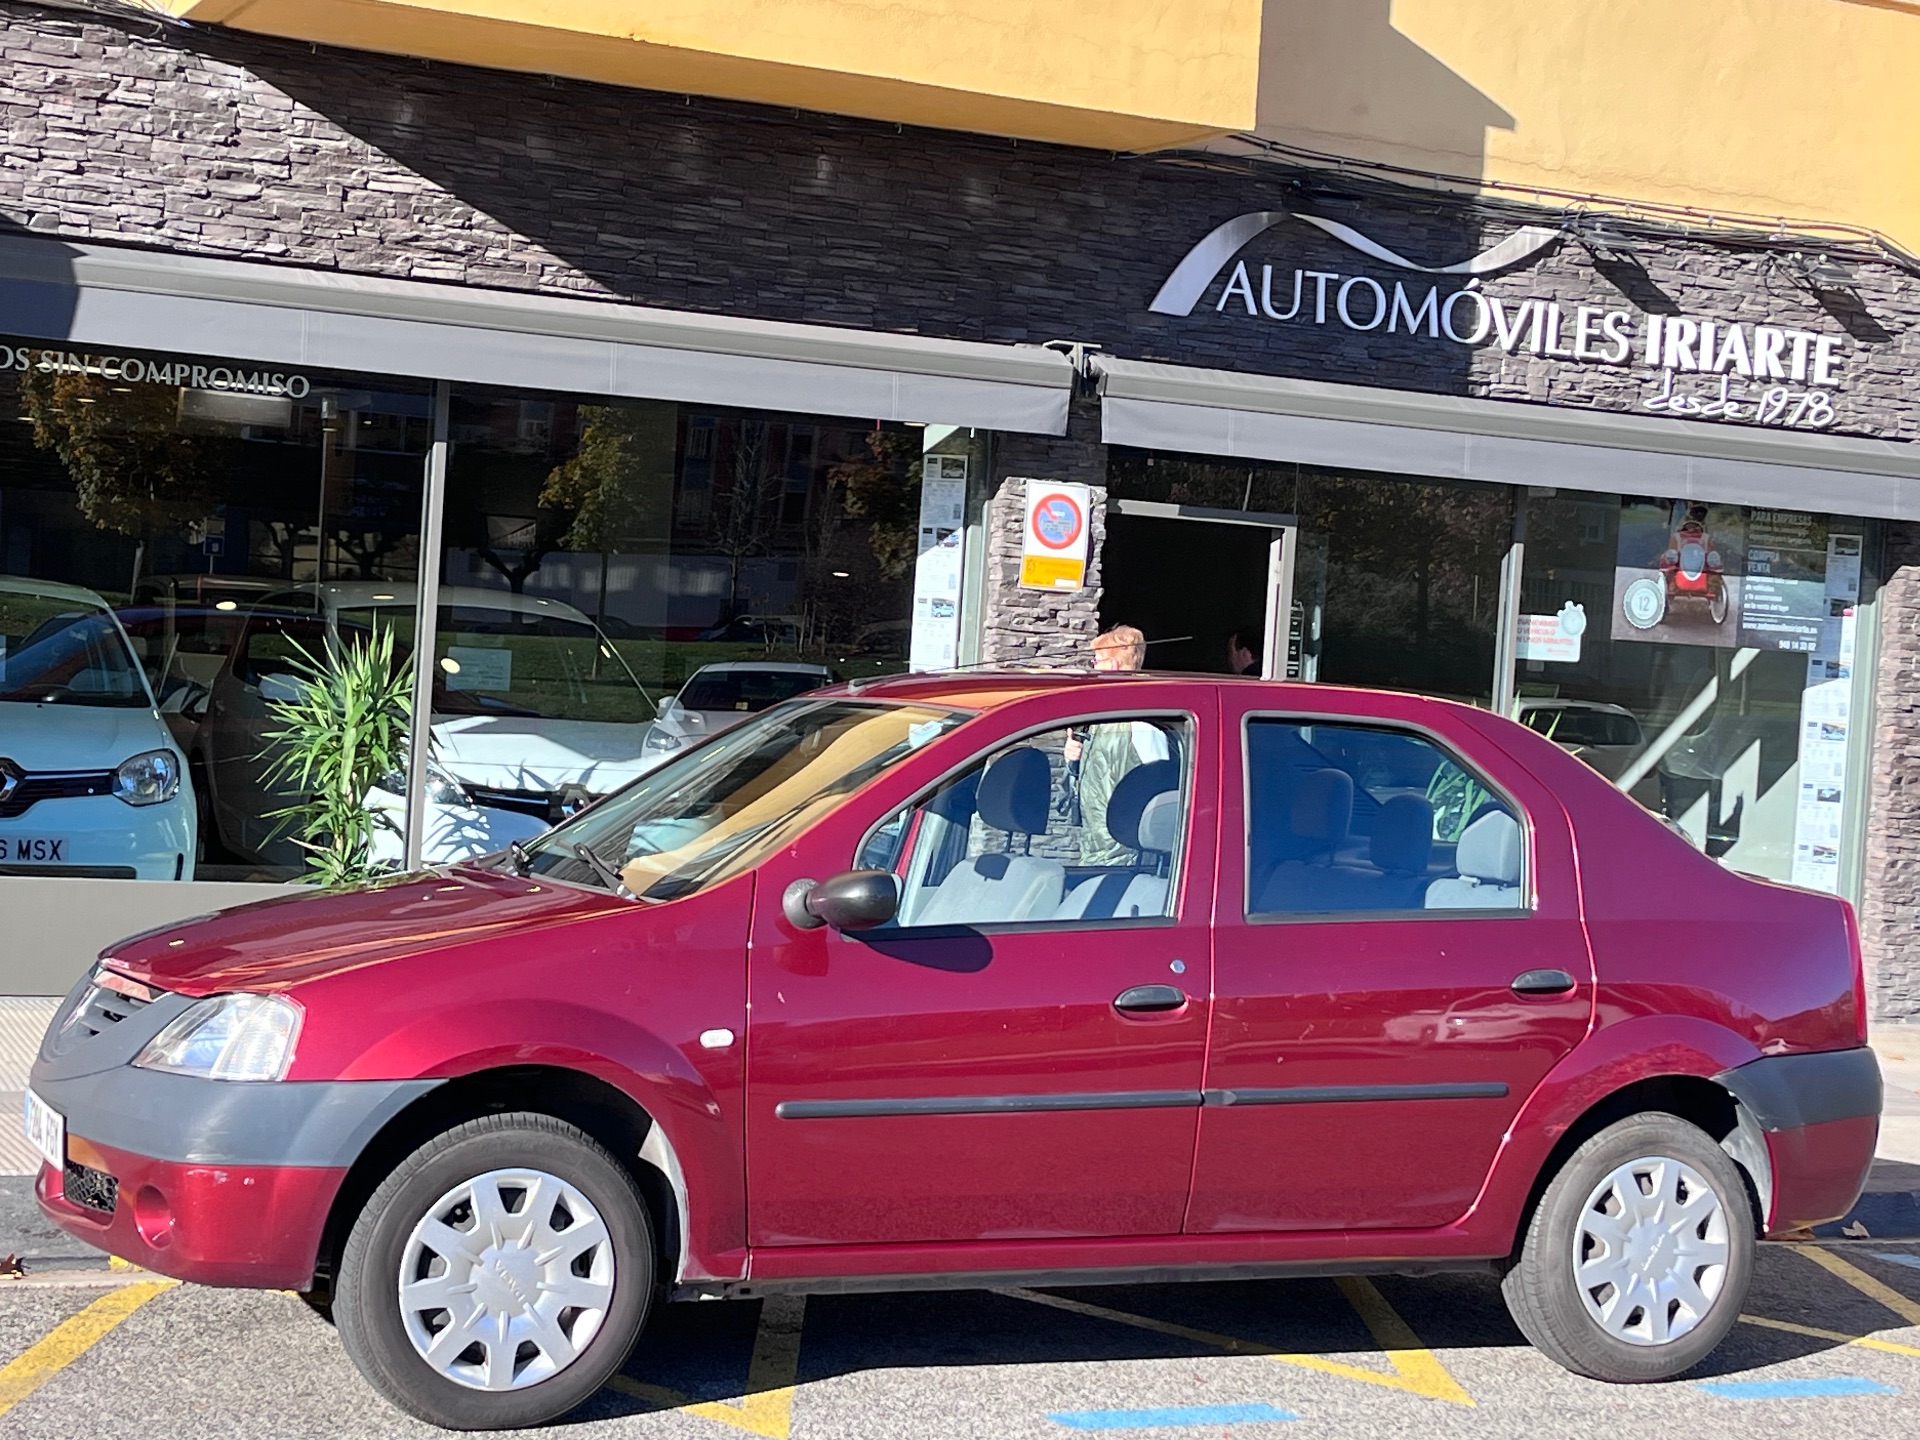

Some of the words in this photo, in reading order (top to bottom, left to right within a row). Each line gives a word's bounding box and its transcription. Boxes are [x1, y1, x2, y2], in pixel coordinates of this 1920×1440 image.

[1216, 260, 1633, 365] AUTOMÓVILES
[1644, 313, 1843, 387] IRIARTE
[39, 350, 90, 376] SIN
[99, 355, 311, 399] COMPROMISO
[1642, 367, 1745, 419] desde
[1756, 386, 1835, 428] 1978
[1639, 597, 1650, 611] 12
[17, 839, 63, 861] MSX
